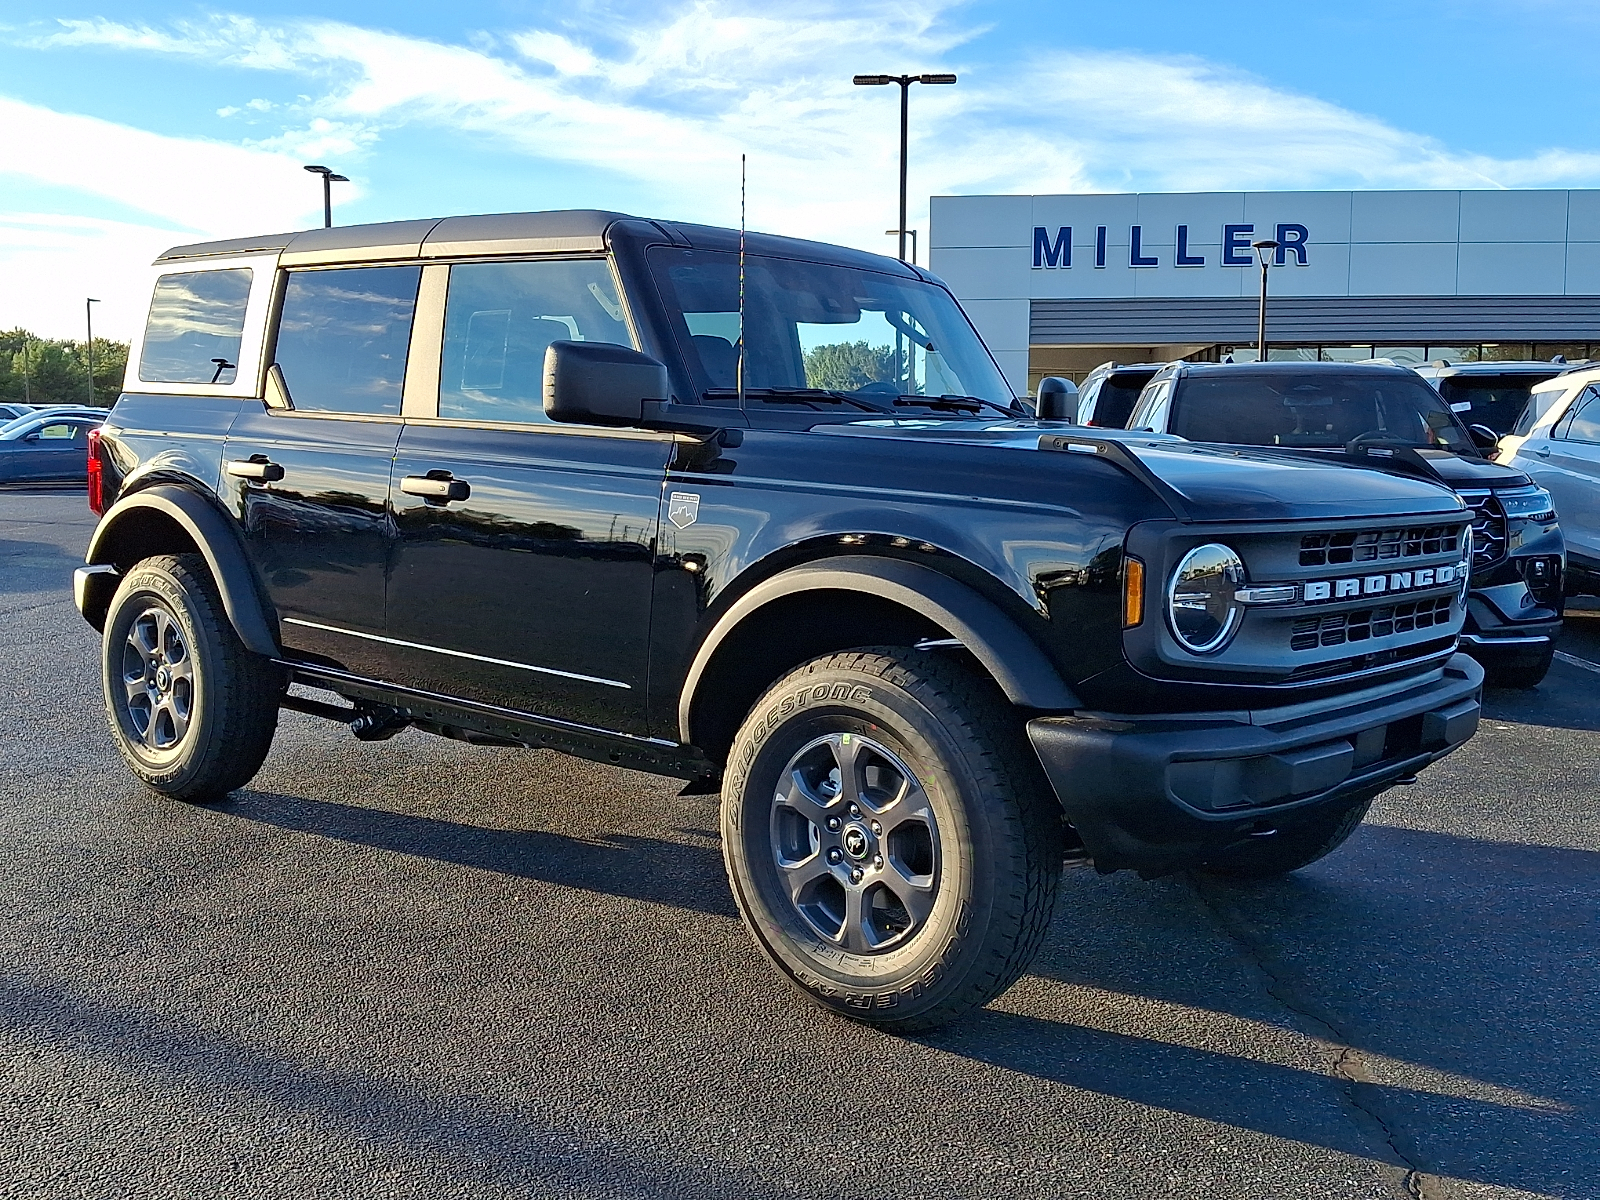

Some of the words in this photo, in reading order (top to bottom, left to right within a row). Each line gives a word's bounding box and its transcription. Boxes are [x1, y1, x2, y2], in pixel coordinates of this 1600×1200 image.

[1031, 223, 1310, 269] MILLER
[1304, 565, 1454, 602] BRONCO
[728, 682, 873, 830] BRIDGESTONE
